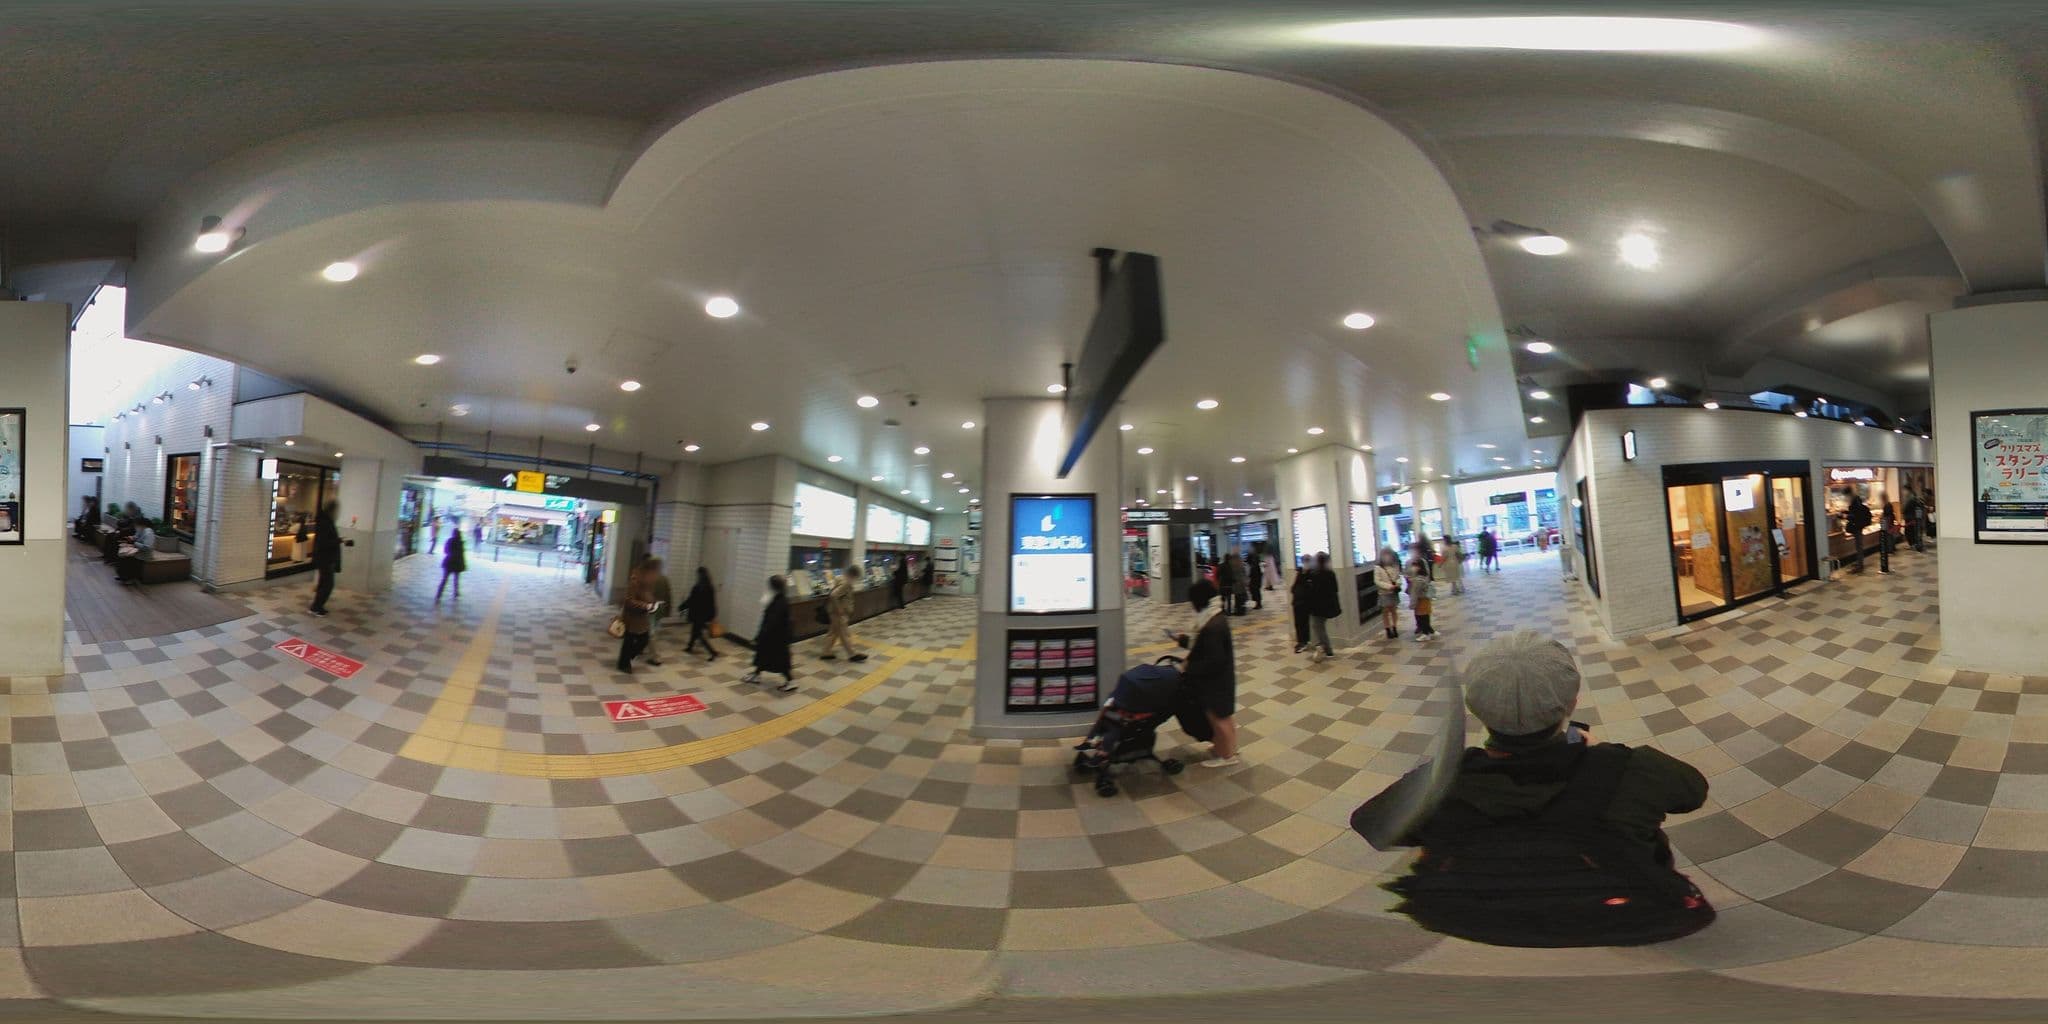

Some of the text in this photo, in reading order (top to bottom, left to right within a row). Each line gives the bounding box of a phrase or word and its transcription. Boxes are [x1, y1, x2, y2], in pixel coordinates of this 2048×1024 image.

[1995, 454, 2048, 467] スタンプ
[2001, 468, 2039, 480] ラリー
